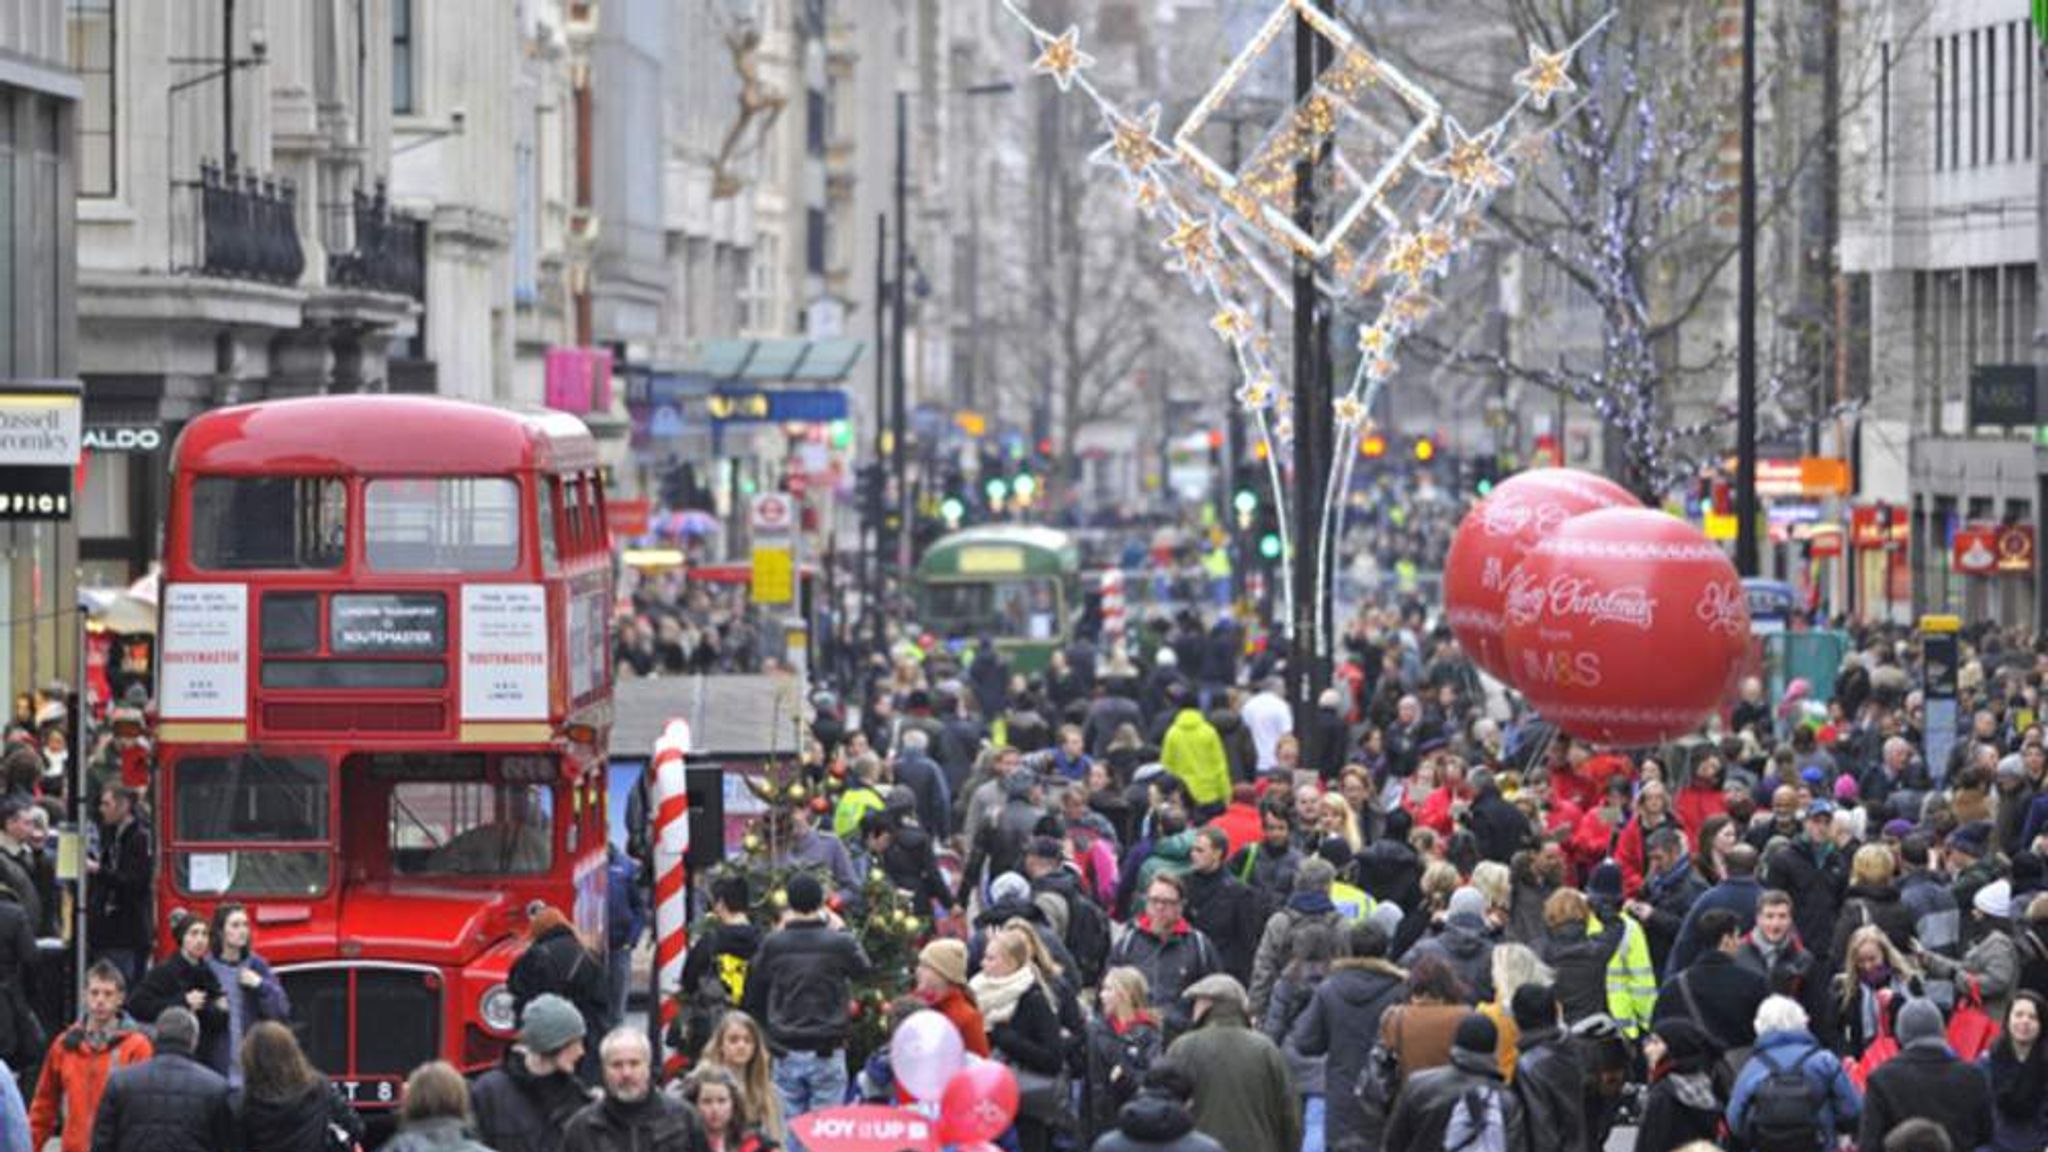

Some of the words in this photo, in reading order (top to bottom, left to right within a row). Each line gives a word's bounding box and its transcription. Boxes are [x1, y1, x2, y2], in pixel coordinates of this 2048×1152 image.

[82, 429, 160, 449] ALDO
[1548, 573, 1658, 631] Christmas
[343, 630, 434, 645] ROUTEMASTER
[1523, 649, 1601, 688] M&S
[811, 1118, 856, 1139] JOY
